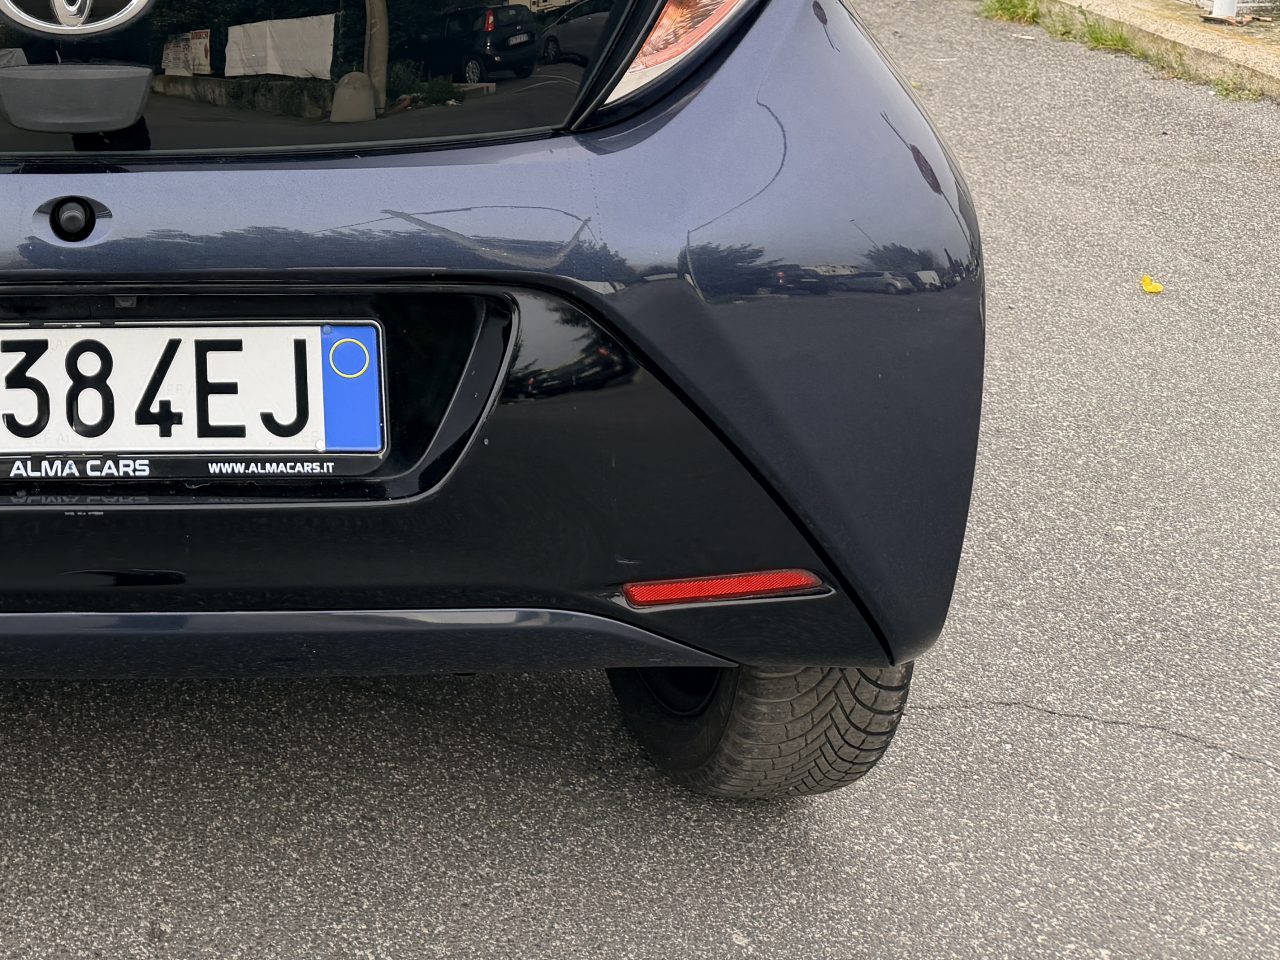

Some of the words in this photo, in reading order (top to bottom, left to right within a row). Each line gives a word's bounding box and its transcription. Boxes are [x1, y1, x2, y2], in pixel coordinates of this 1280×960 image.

[10, 460, 79, 477] ALMA
[85, 459, 150, 477] CARS
[208, 462, 335, 474] WWW.ALMACARS.IT
